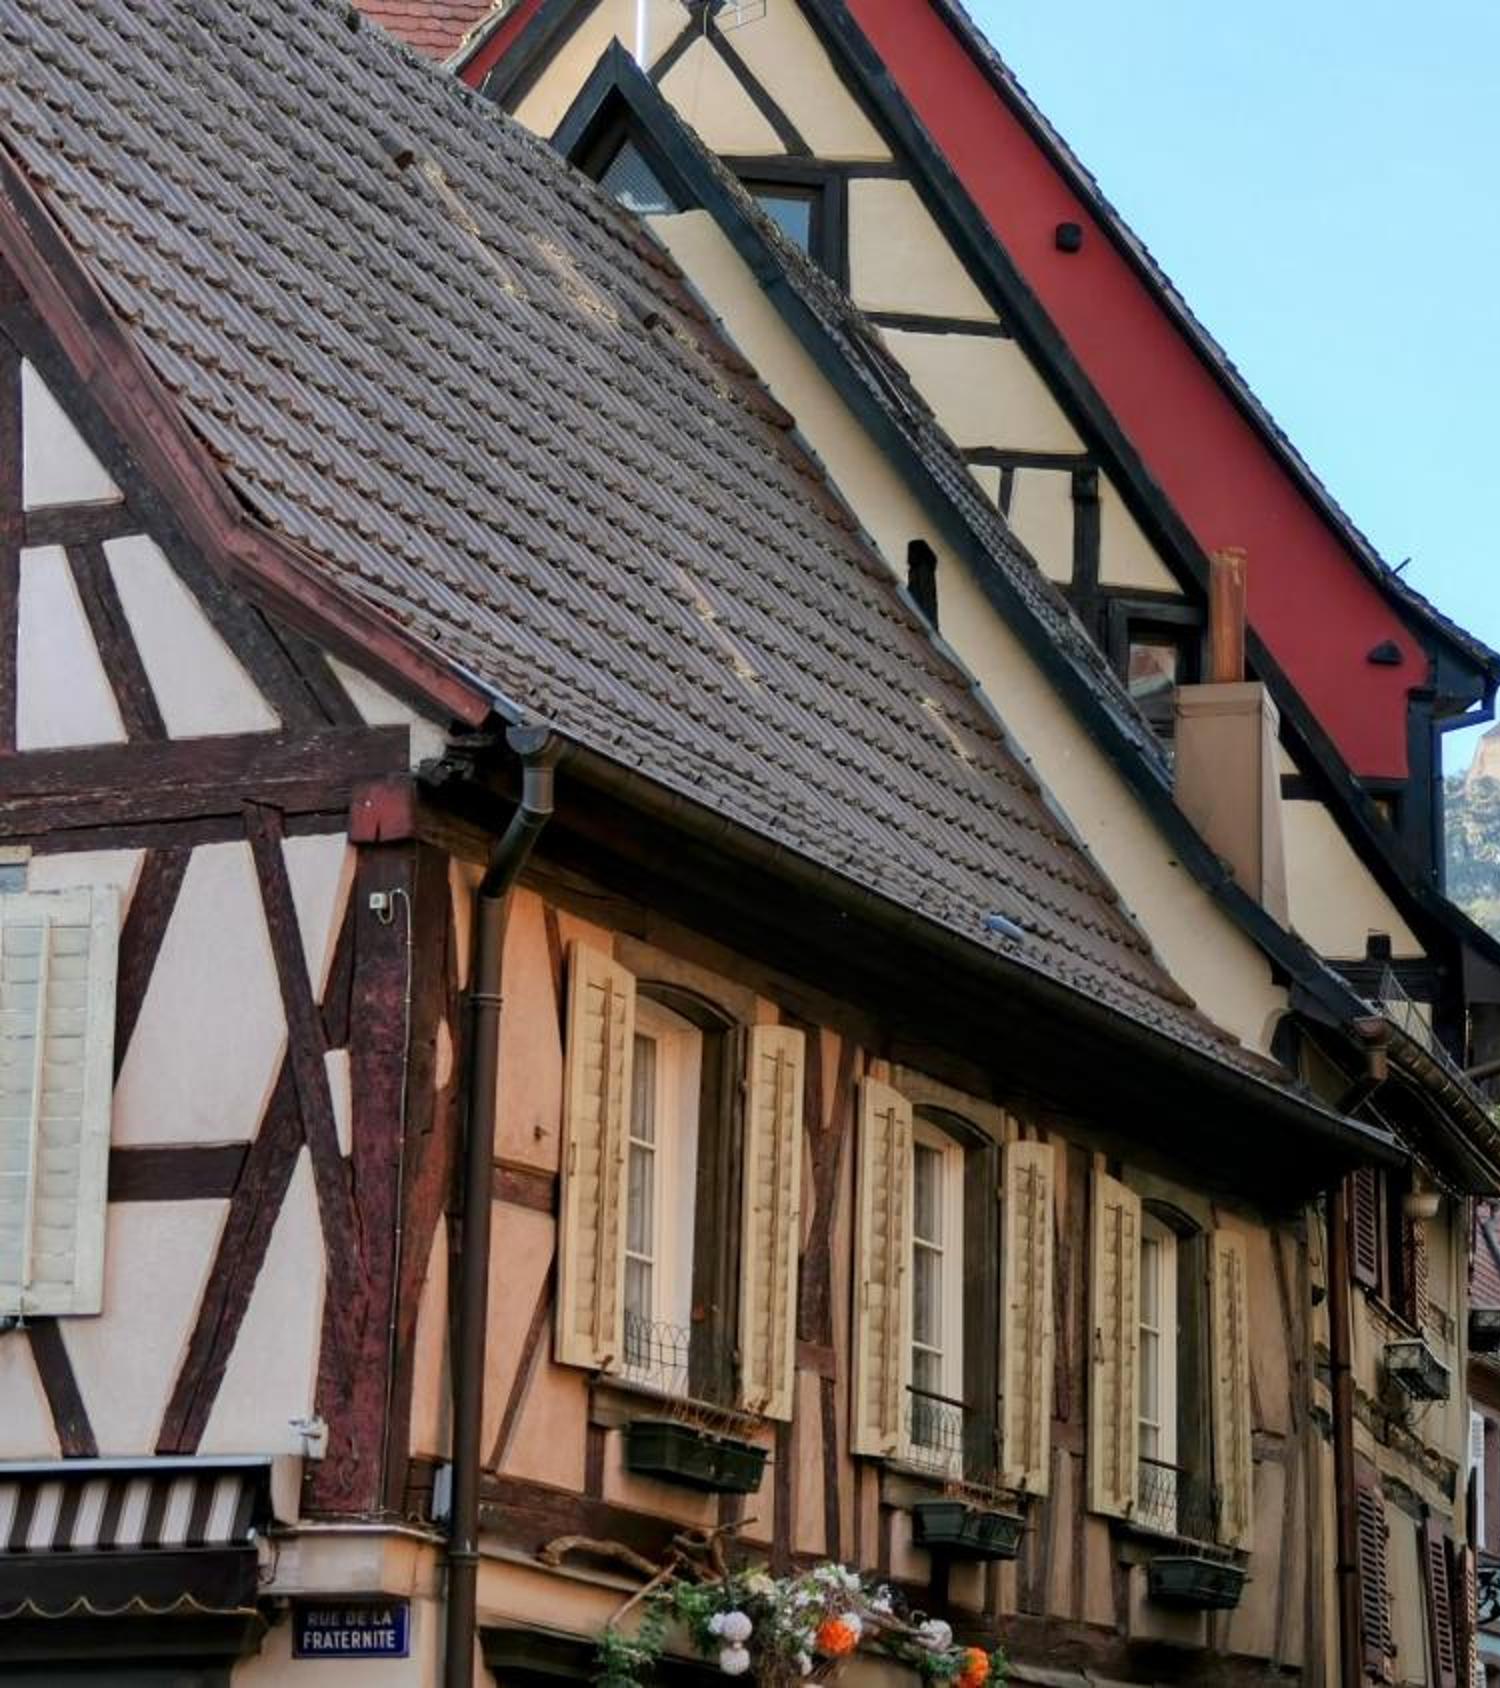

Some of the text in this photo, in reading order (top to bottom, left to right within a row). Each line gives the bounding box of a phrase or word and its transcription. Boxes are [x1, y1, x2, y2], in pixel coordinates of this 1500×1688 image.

[307, 1609, 393, 1627] RUE DE LA
[303, 1629, 396, 1649] FRATERNITE
